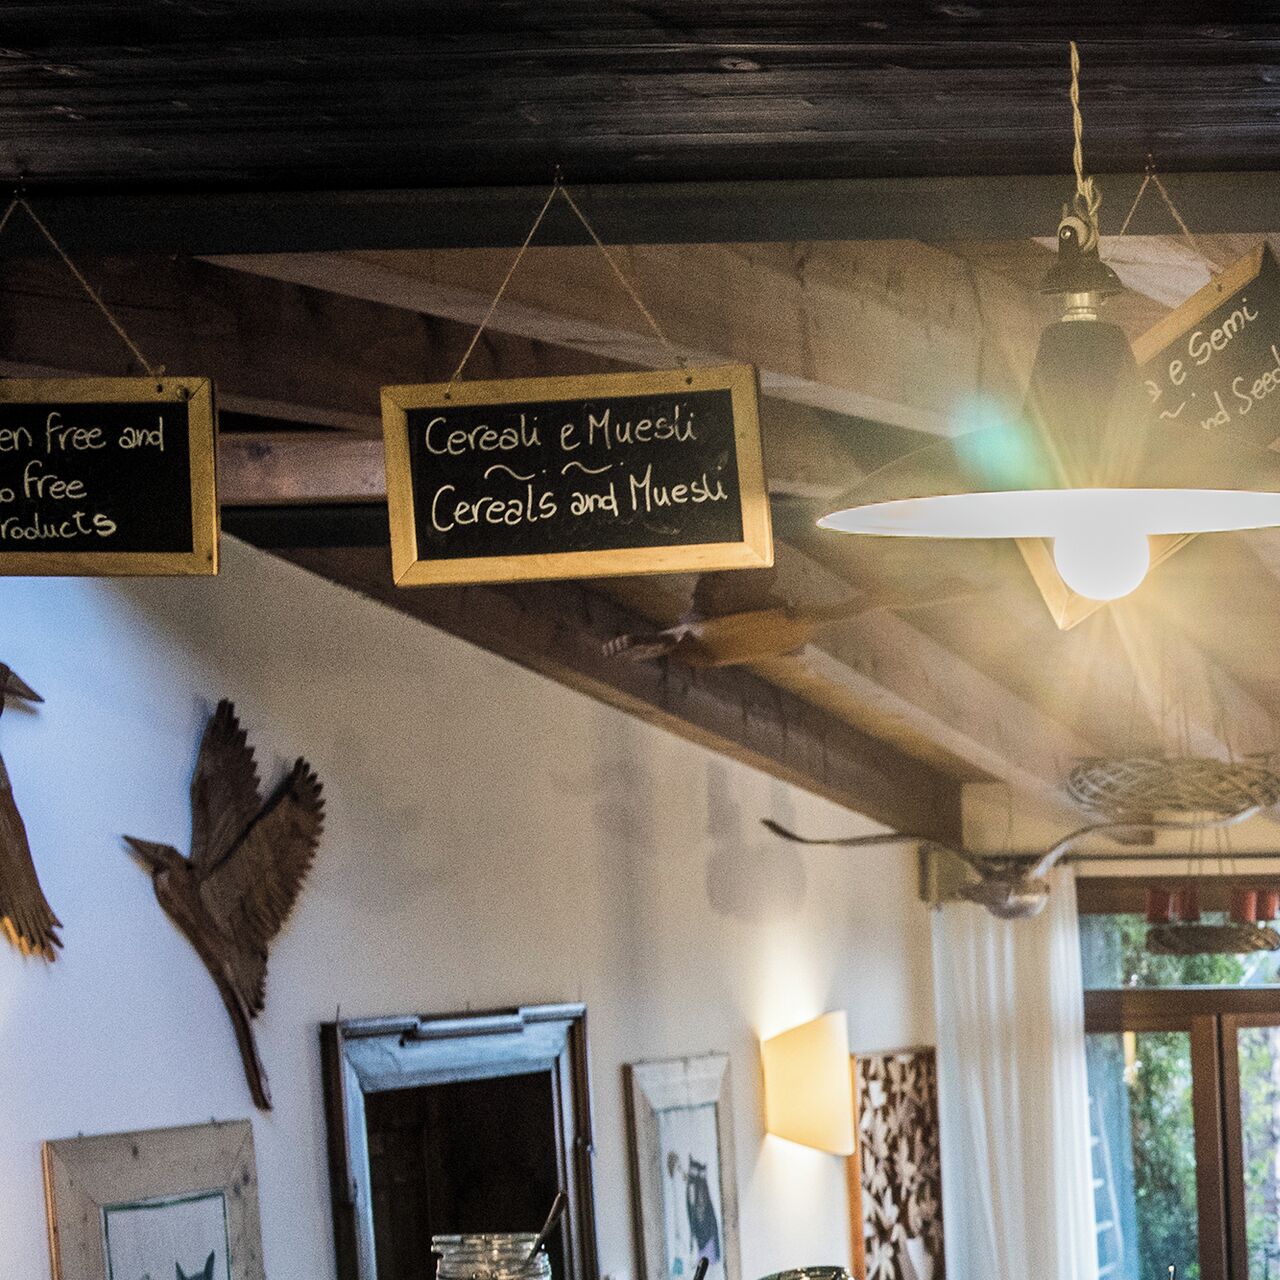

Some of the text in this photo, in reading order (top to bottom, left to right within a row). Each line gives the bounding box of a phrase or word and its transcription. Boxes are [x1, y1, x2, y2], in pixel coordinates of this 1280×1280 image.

[1188, 297, 1259, 366] Semi
[46, 412, 106, 453] free
[119, 416, 164, 451] and
[426, 403, 698, 455] Cereali e Muesli
[1200, 391, 1231, 430] nd
[24, 460, 87, 499] free
[431, 462, 729, 532] Cereals and Muesli
